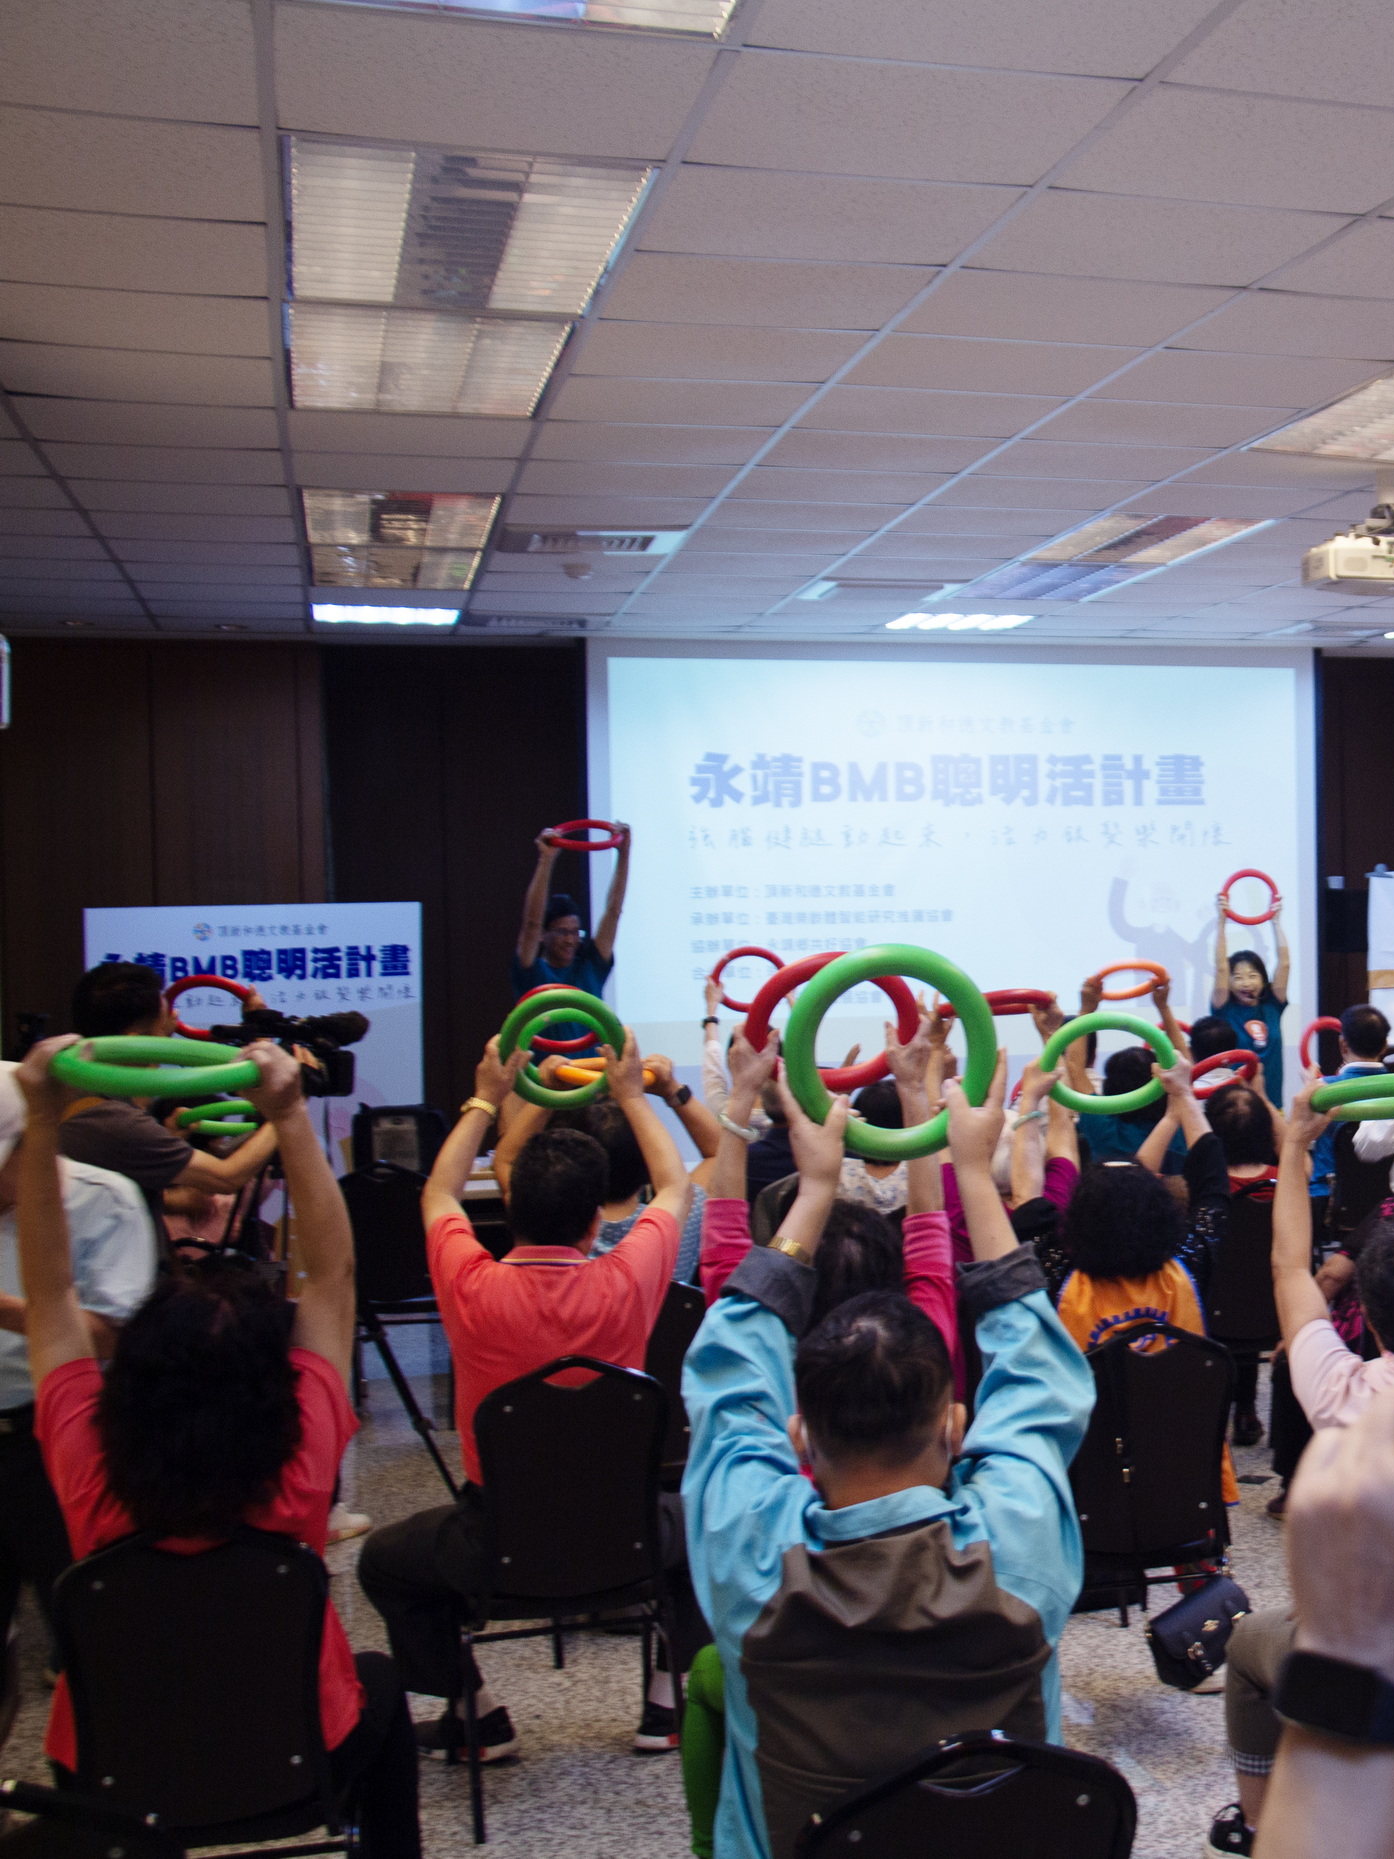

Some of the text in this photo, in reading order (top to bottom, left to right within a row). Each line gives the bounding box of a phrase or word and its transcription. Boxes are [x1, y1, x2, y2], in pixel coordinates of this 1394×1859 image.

[689, 752, 1208, 808] 永靖BMB聰明活計畫
